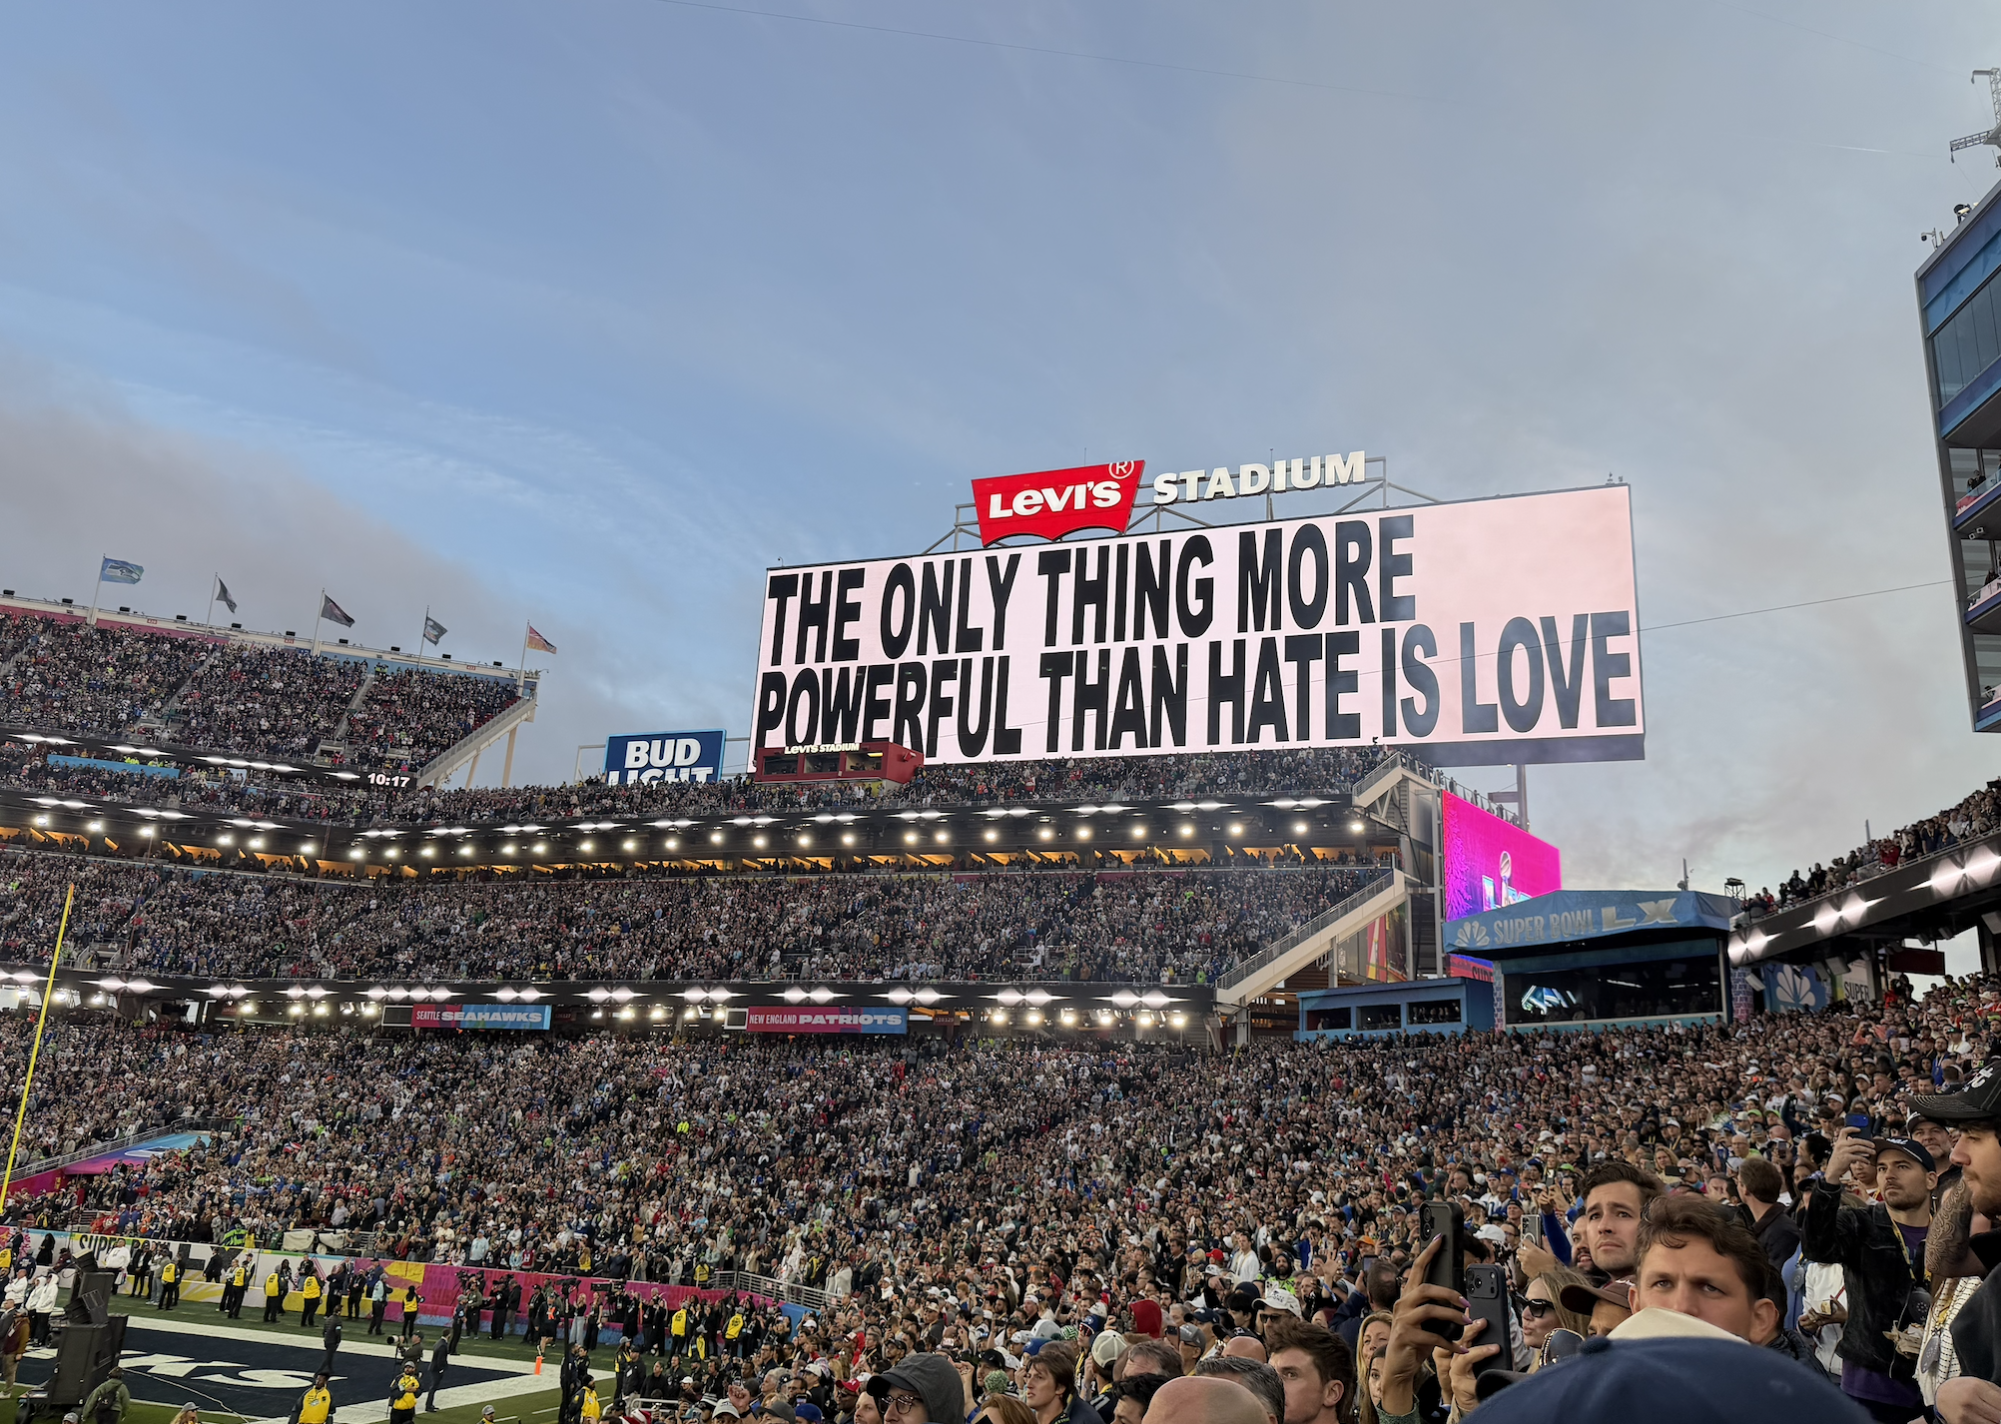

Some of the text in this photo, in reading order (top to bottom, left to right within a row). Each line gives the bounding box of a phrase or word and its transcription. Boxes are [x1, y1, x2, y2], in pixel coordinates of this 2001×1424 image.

[1153, 450, 1365, 504] STADIUM
[768, 514, 1416, 666] THE ONLY THING MORE
[755, 610, 1636, 758] POWERFUL THAN HATE IS LOVE
[624, 738, 702, 769] BUD
[819, 743, 860, 752] STADIUM
[367, 772, 410, 788] 10:17
[1493, 898, 1679, 945] SUPER BOWL LX
[1844, 980, 1870, 1001] SUPER
[416, 1010, 542, 1022] SEATTLE SEAHAWKS
[749, 1014, 902, 1025] NEW ENGLAND PATRIOTS
[79, 1234, 120, 1260] SUPE
